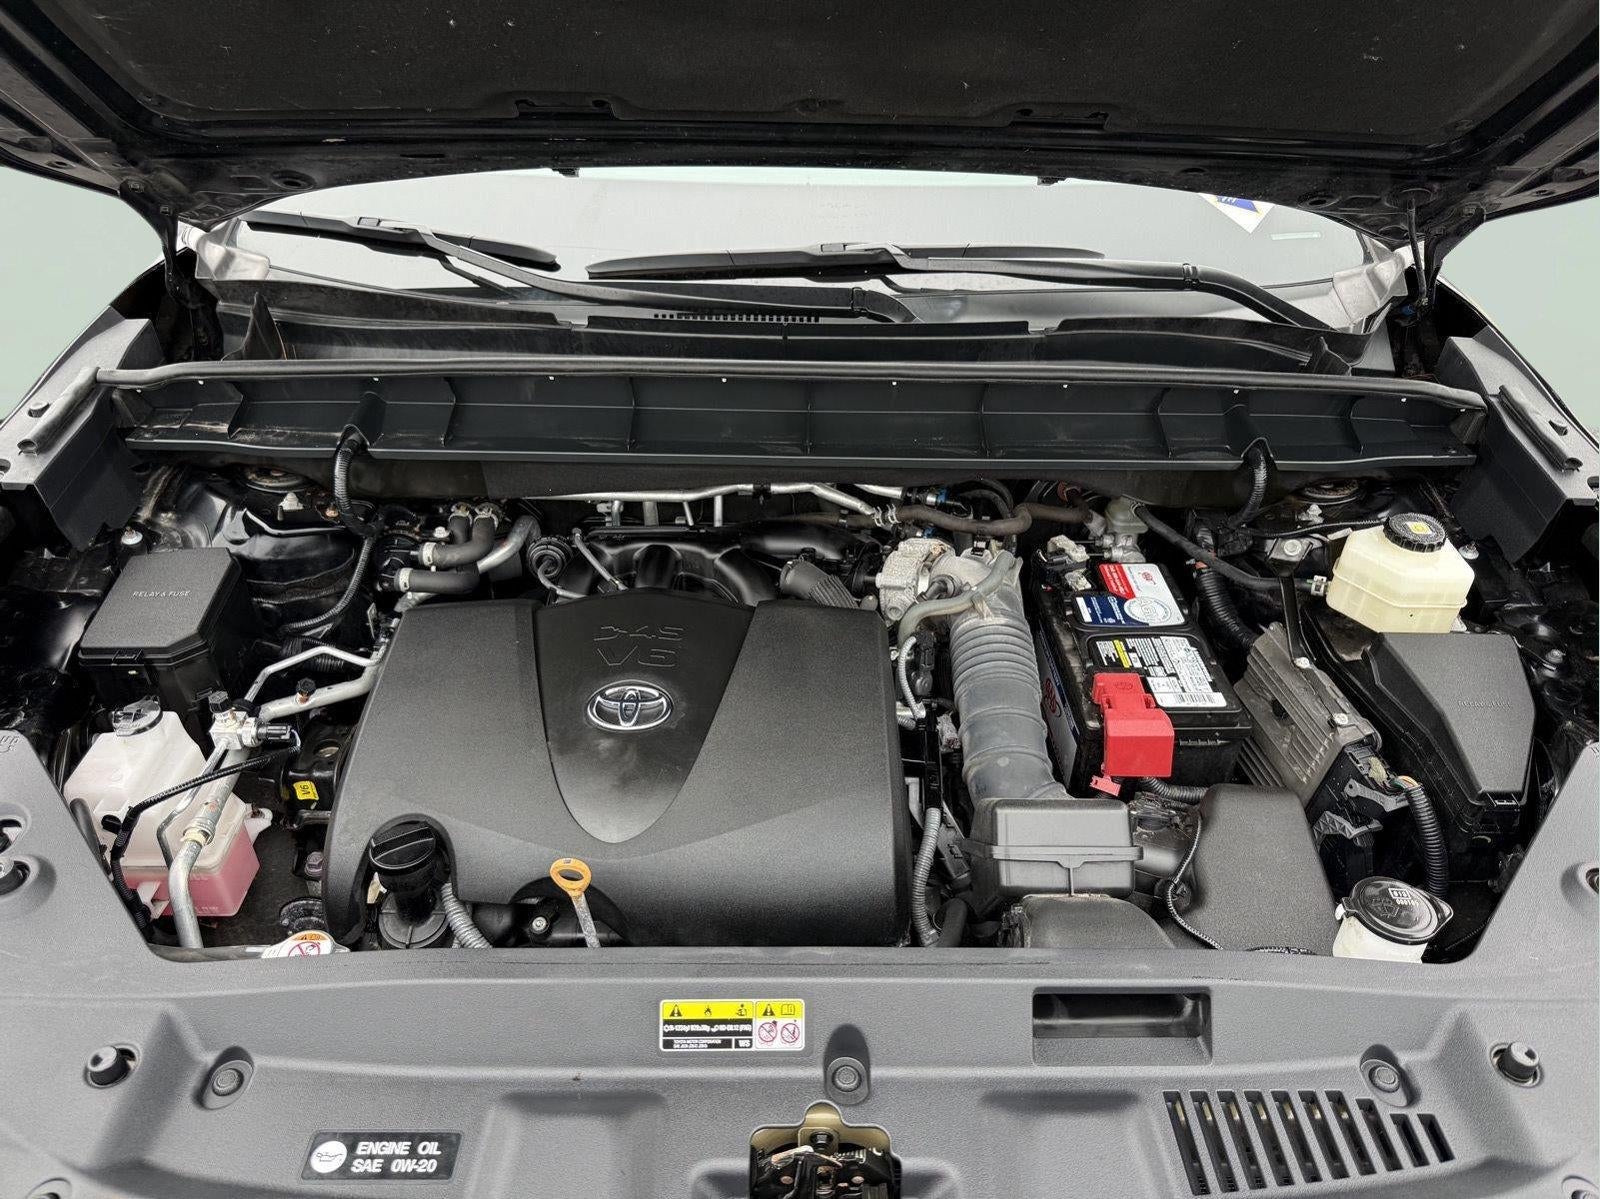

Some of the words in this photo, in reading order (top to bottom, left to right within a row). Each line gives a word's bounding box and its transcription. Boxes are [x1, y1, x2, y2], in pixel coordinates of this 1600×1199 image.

[597, 645, 676, 667] V6
[355, 1141, 411, 1155] ENGINE
[417, 1141, 442, 1155] OIL
[350, 1158, 384, 1173] SAE
[390, 1158, 438, 1173] 0W-20
